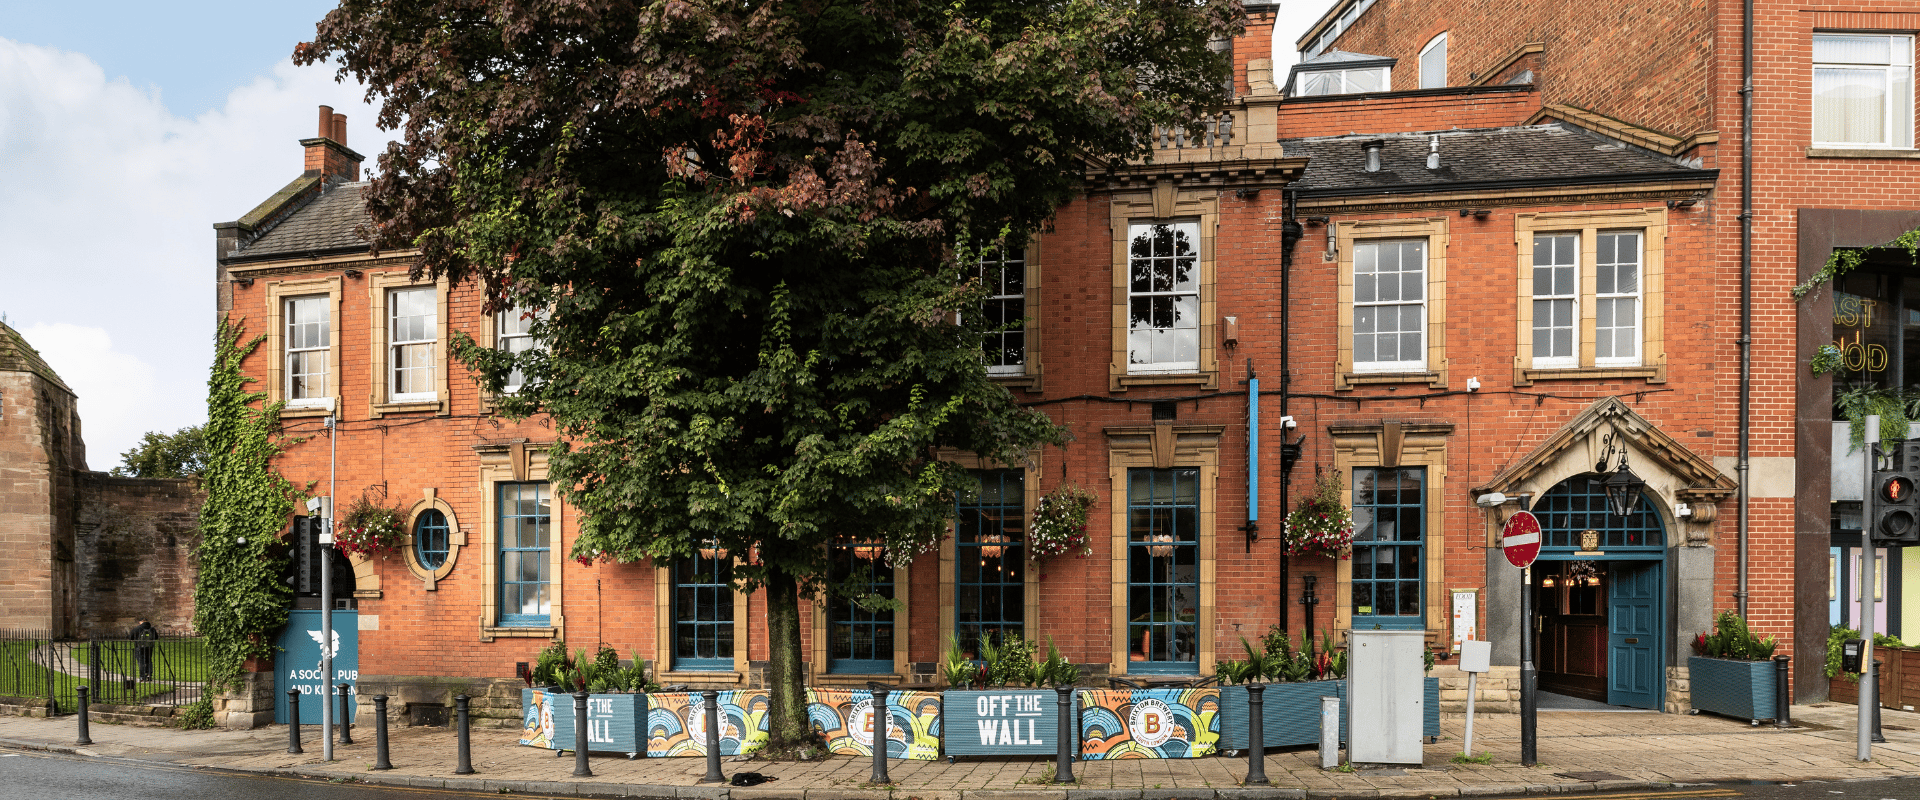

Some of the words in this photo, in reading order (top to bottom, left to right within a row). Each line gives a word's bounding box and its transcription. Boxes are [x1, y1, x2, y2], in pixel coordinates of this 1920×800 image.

[290, 669, 298, 680] A
[298, 669, 336, 680] SOCI
[337, 670, 358, 680] PUB
[596, 698, 613, 714] THE
[849, 700, 870, 724] BRIXTON
[977, 695, 1013, 717] OFF
[1014, 694, 1043, 712] THE
[1130, 700, 1150, 726] BRIXTON
[1150, 699, 1174, 725] BREWERY
[574, 719, 614, 743] ALL
[977, 719, 1043, 746] WALL
[1144, 712, 1161, 734] B
